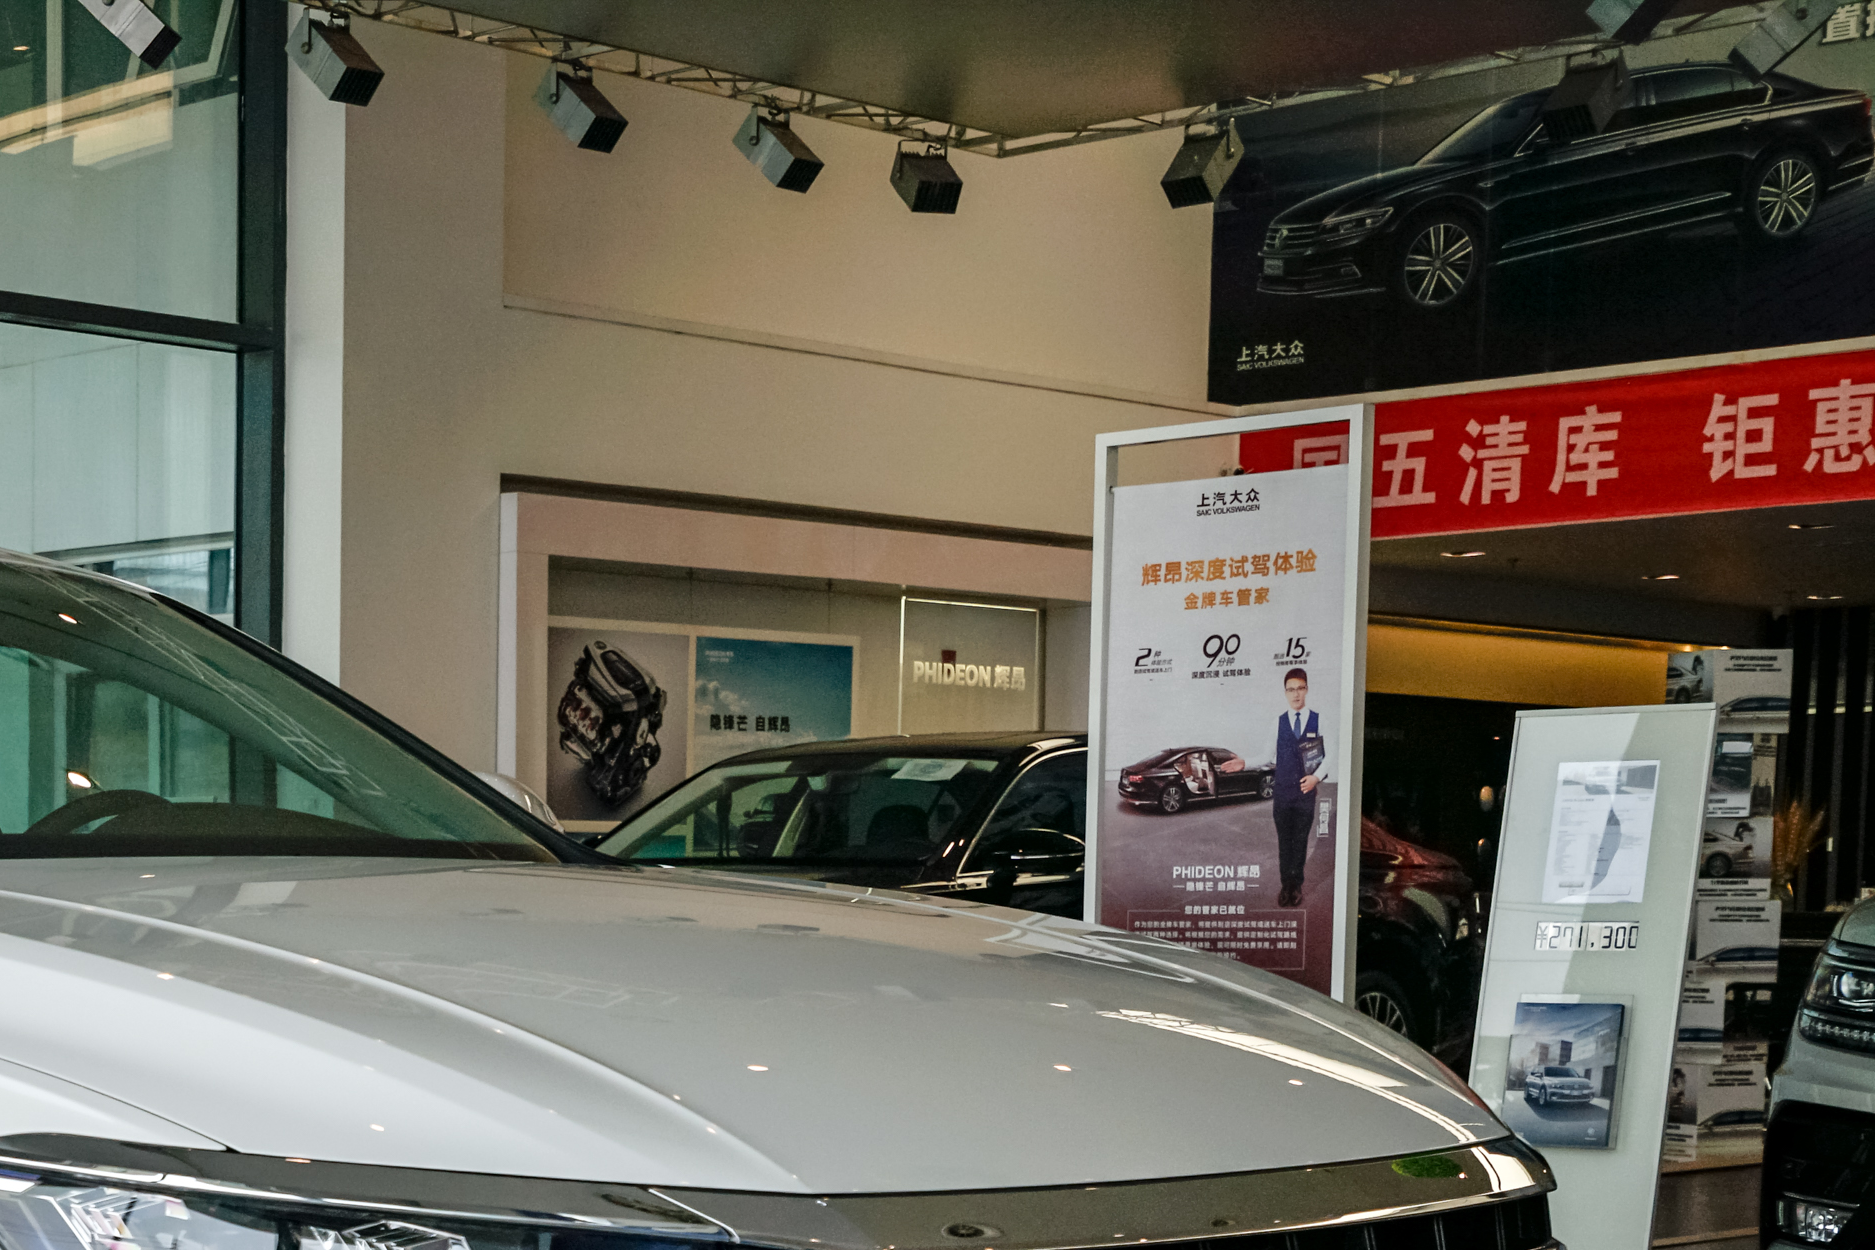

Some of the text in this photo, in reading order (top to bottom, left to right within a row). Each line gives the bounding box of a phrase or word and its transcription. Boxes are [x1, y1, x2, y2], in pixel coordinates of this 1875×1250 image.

[1236, 340, 1304, 362] 上汽大众
[1196, 488, 1260, 508] 上汽大众
[1196, 504, 1260, 517] SAIC VOLKSWAGEN
[1141, 548, 1317, 586] 辉昂深度试驾体验
[1184, 587, 1270, 610] 金牌车管家
[912, 661, 1026, 691] PHIDEON 辉昂
[1172, 865, 1260, 879] PHIDEON 辉昂
